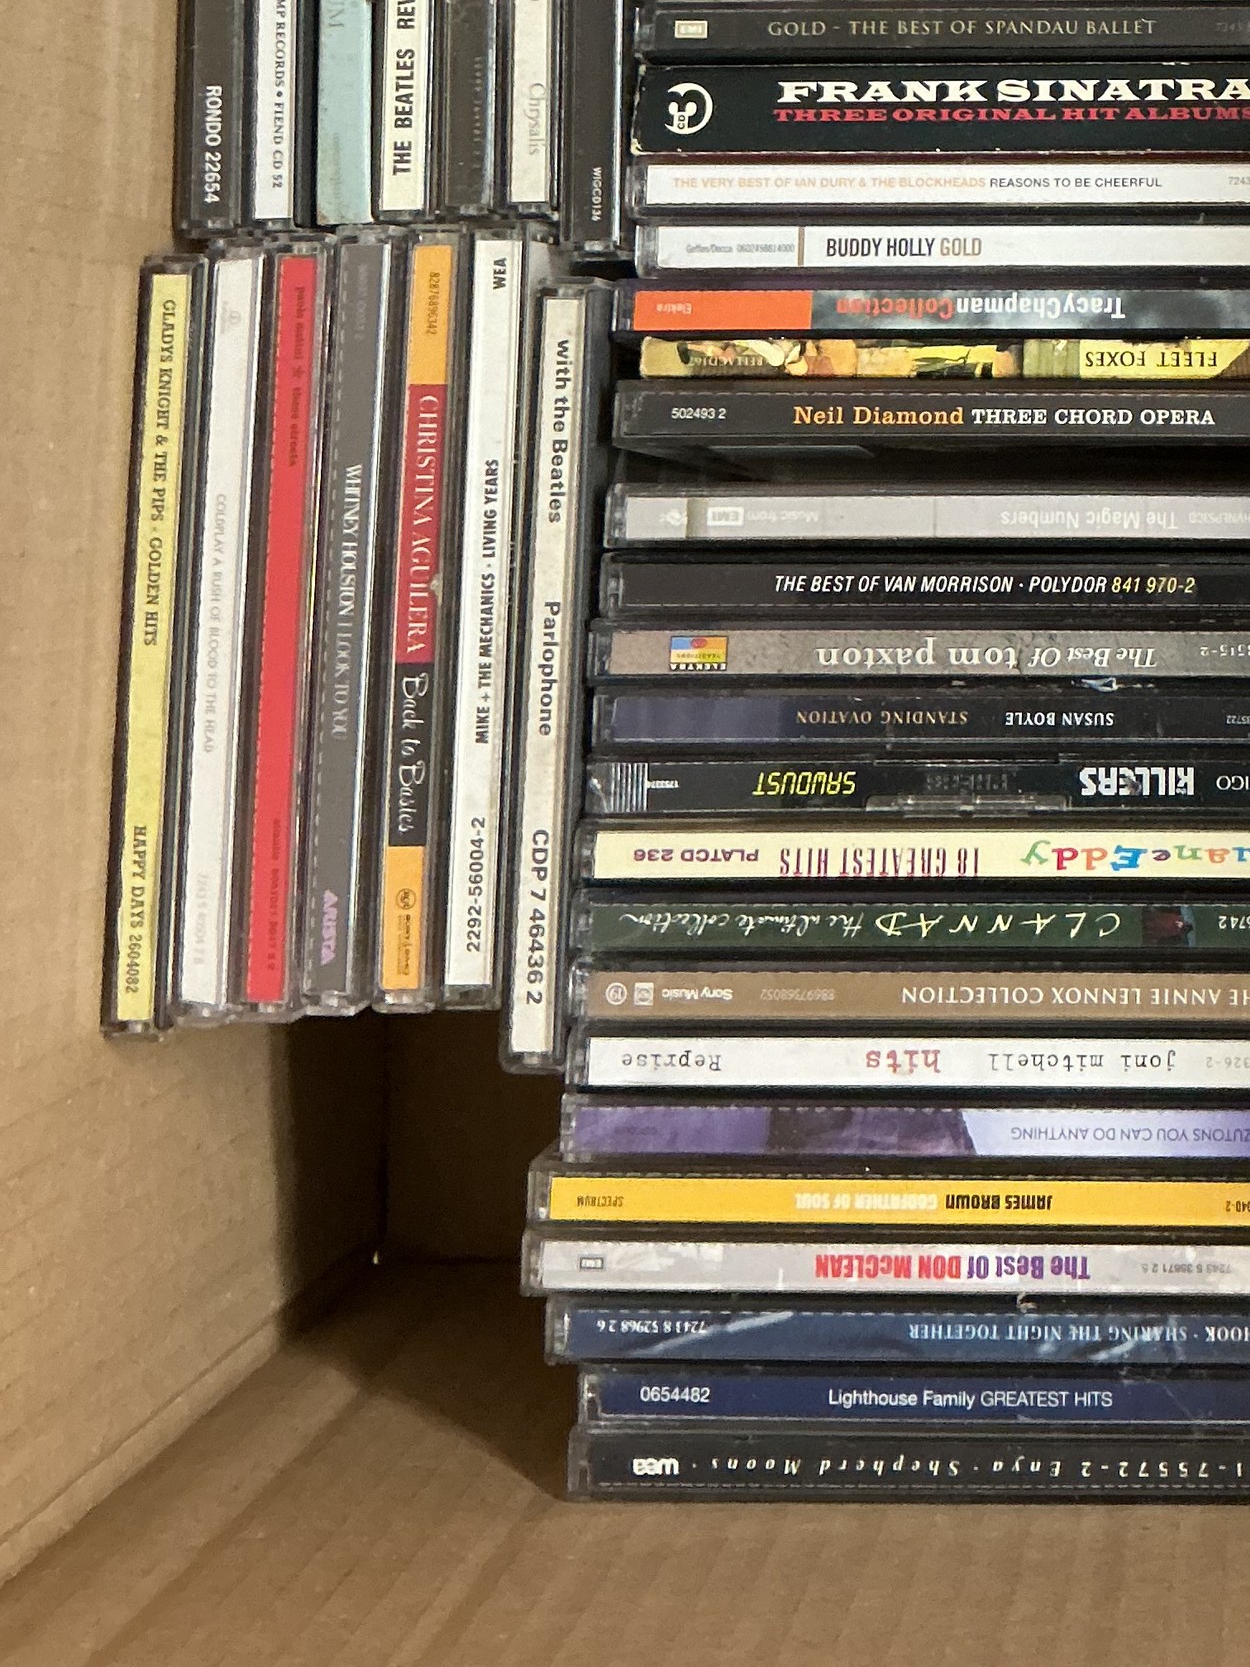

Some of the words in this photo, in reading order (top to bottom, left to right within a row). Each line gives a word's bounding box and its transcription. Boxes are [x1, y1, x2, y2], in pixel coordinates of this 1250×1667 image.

[394, 49, 414, 128] BEATLES
[777, 81, 987, 102] FRANK
[205, 86, 222, 146] RONDO
[774, 109, 887, 121] THREE
[893, 109, 1056, 121] ORIGINAL
[1062, 108, 1119, 120] HIT
[393, 141, 411, 175] THE
[204, 152, 221, 203] 22654
[990, 178, 1049, 187] REASONS
[1054, 178, 1070, 187] TO
[1075, 178, 1090, 187] BE
[1095, 178, 1161, 187] CHEERFUL
[827, 238, 882, 257] BUDDY
[887, 238, 934, 256] HOLLY
[941, 238, 981, 256] GOLD
[493, 258, 506, 289] WEA
[160, 300, 176, 367] GLADYS
[555, 340, 572, 389] with
[1086, 351, 1145, 367] FOXES
[1160, 351, 1217, 367] FLEET
[157, 368, 172, 429] KNIGHT
[553, 396, 570, 432] the
[156, 435, 168, 445] &
[153, 452, 167, 481] THE
[549, 440, 568, 523] Beatles
[151, 482, 166, 521] PIPS
[484, 460, 498, 510] YEARS
[483, 515, 497, 557] LIVING
[146, 537, 162, 605] GOLDEN
[776, 576, 807, 592] THE
[811, 576, 854, 592] BEST
[858, 576, 880, 592] OF
[885, 576, 916, 592] VAN
[921, 576, 1013, 592] MORRISON
[1029, 576, 1107, 592] POLYDOR
[1112, 577, 1140, 592] 841
[1146, 577, 1195, 593] 970-2
[144, 612, 158, 645] HITS
[479, 574, 495, 657] MECHANICS
[478, 657, 491, 688] THE
[538, 602, 561, 735] Parlophone
[476, 707, 489, 743] MIKE
[132, 826, 147, 879] HAPPY
[532, 830, 549, 881] CDP
[467, 818, 485, 952] 2292-56004-2
[531, 889, 546, 901] 7
[131, 886, 144, 928] DAYS
[527, 909, 545, 984] 46436
[125, 935, 142, 993] 2604082
[527, 991, 542, 1004] 2
[622, 1050, 721, 1071] Reprise
[866, 1050, 940, 1074] hits
[989, 1049, 1103, 1072] mitchell
[1121, 1050, 1175, 1071] joni
[640, 1386, 710, 1402] 0654482
[829, 1389, 917, 1408] Lighthouse
[923, 1390, 975, 1410] Family
[981, 1391, 1069, 1407] GREATEST
[1075, 1391, 1112, 1407] HITS
